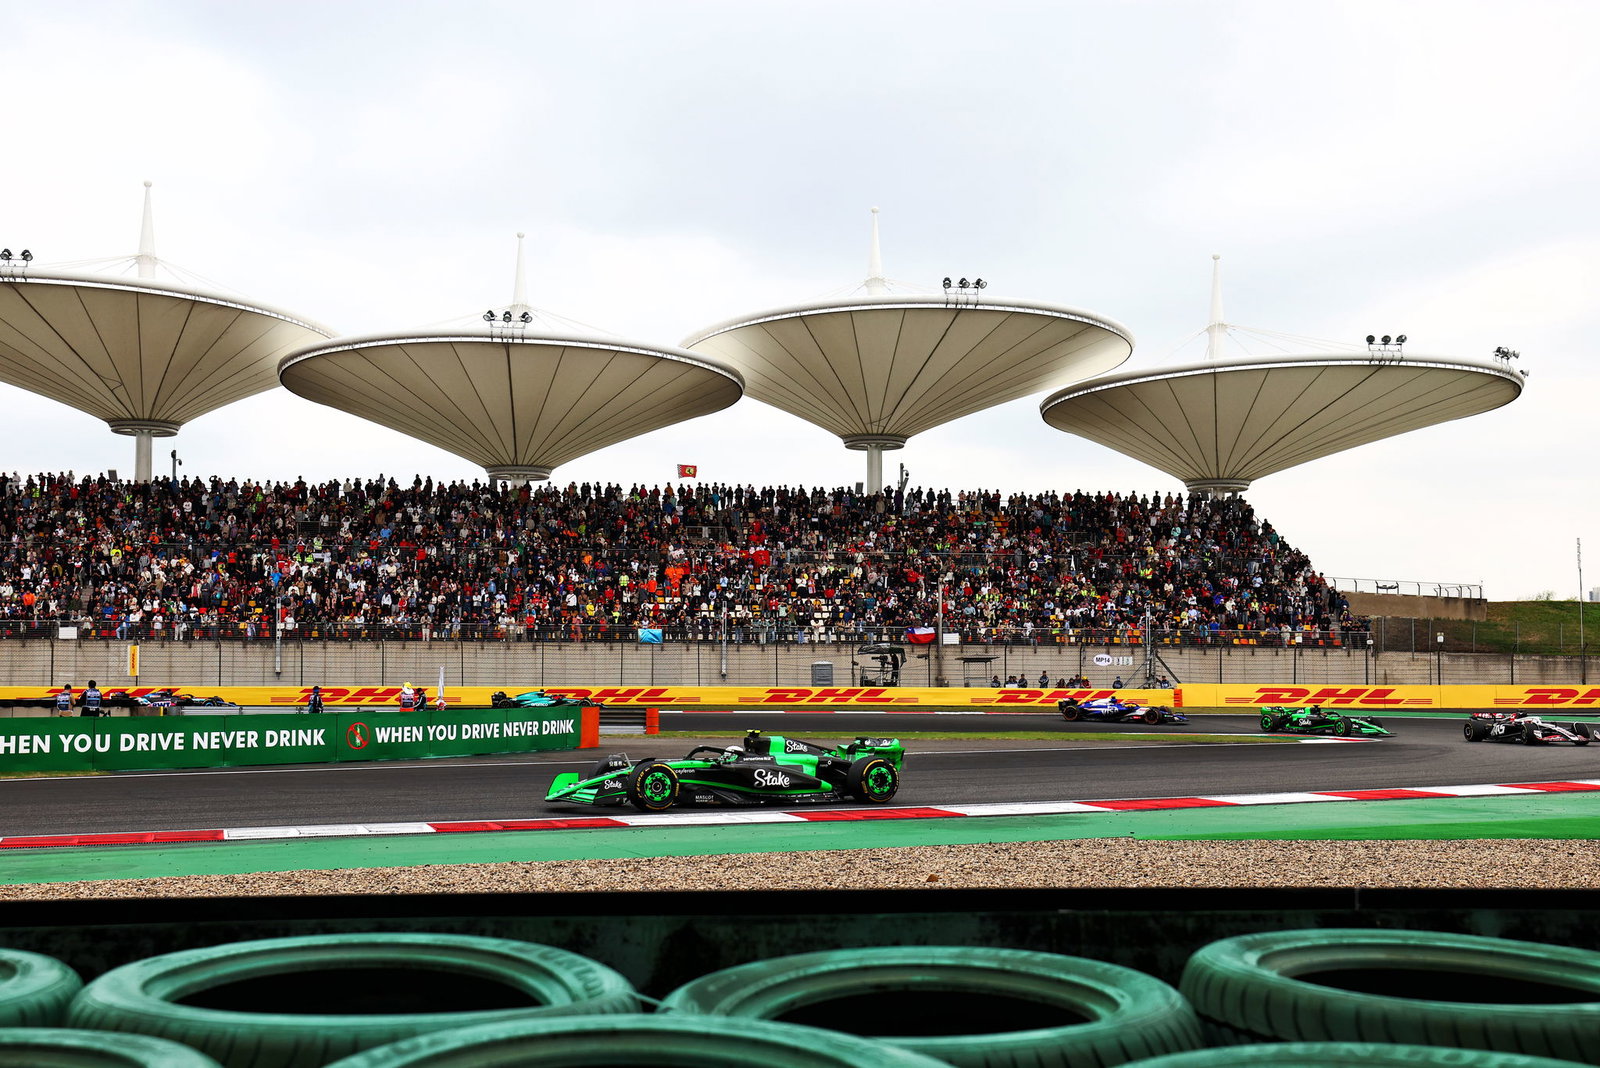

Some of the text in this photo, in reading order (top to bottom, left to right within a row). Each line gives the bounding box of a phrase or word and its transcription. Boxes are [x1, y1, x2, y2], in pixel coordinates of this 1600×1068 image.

[763, 689, 894, 702] DHL
[1253, 688, 1405, 704] DHL
[376, 720, 573, 743] WHEN YOU DRIVE NEVER DRINK
[0, 729, 324, 754] HEN YOU DRIVE NEVER DRINK
[786, 740, 808, 752] Stake
[604, 780, 622, 789] Stake
[754, 769, 790, 788] Stake
